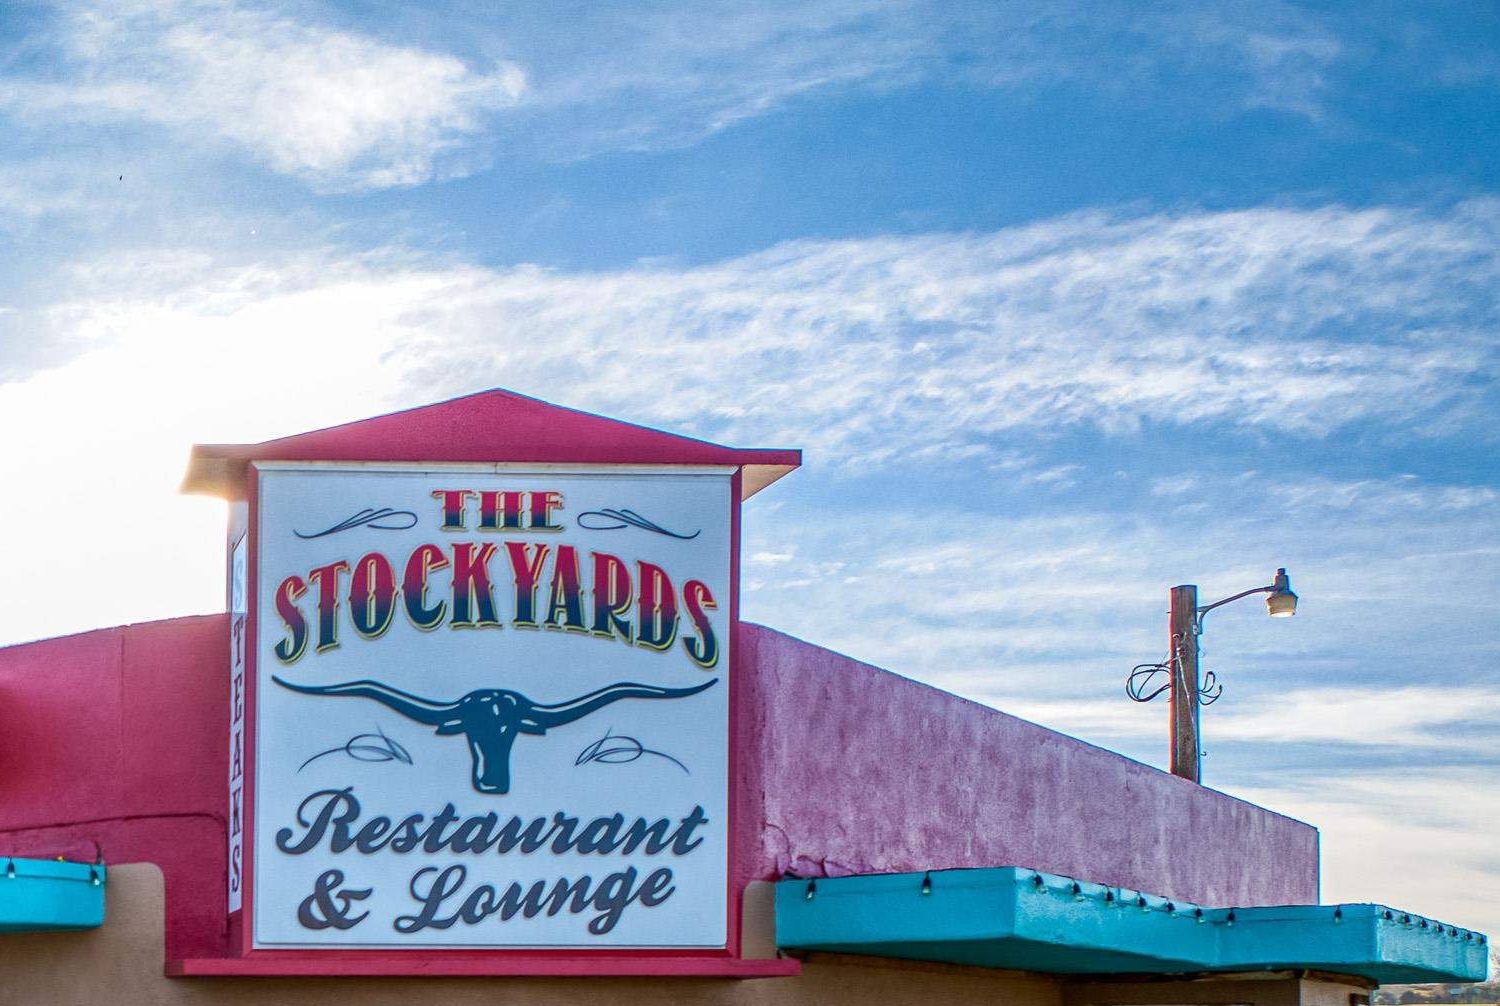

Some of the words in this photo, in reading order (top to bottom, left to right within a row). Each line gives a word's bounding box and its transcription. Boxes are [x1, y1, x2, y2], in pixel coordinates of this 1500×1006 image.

[431, 488, 565, 533] THE
[274, 541, 719, 669] STOCKYARDS
[231, 562, 244, 893] STEAKS
[275, 786, 711, 856] Restaurant
[297, 868, 373, 930] &
[393, 863, 676, 935] Lounge
